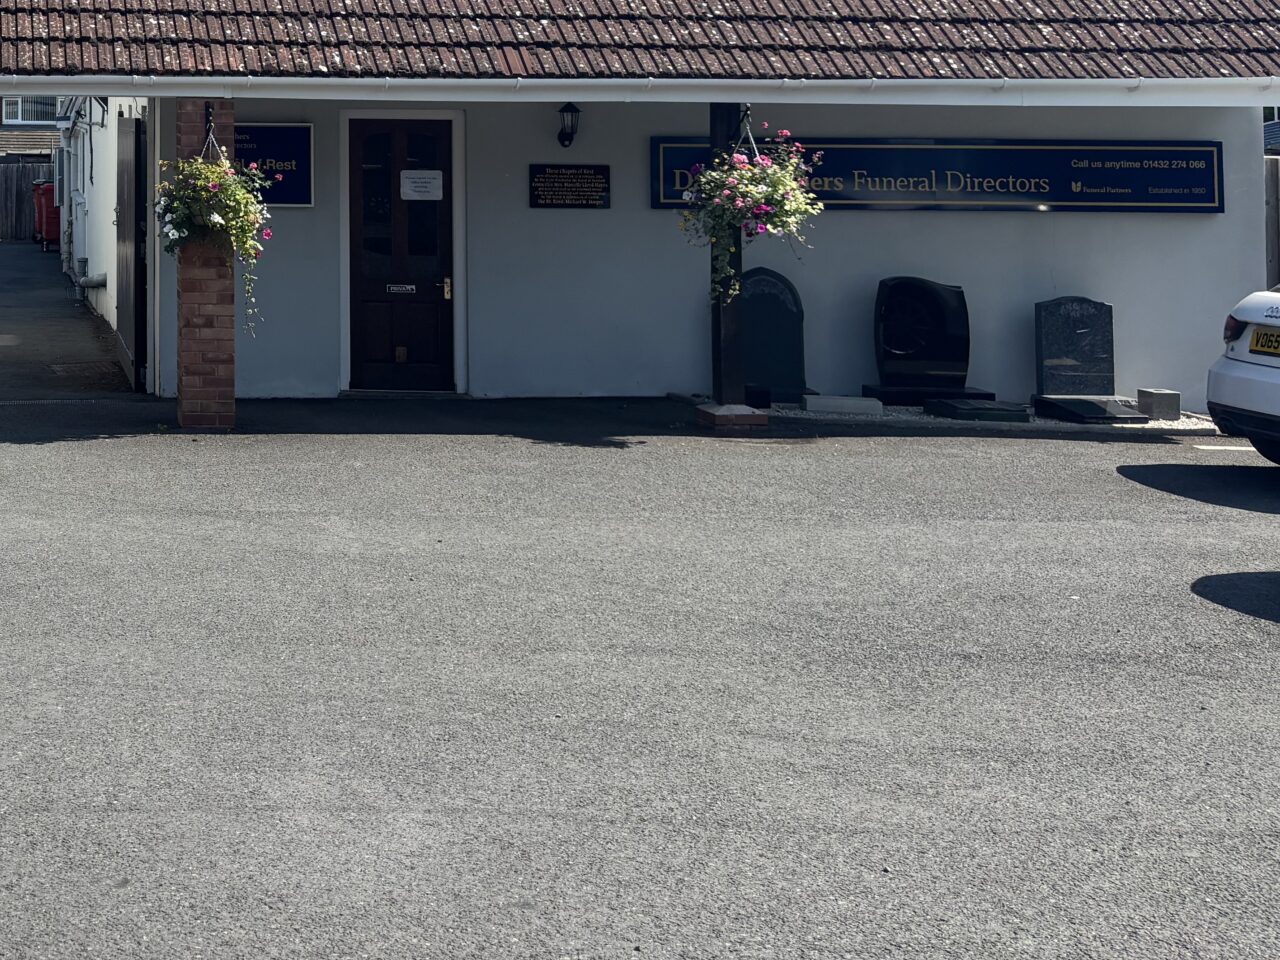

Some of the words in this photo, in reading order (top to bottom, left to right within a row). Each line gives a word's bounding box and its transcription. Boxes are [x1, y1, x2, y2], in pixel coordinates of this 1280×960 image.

[235, 132, 250, 140] hers
[267, 159, 297, 170] Rest
[1071, 159, 1089, 168] Call
[1104, 159, 1141, 170] anytime
[1143, 160, 1170, 169] 01432
[1171, 160, 1187, 169] 274
[1189, 160, 1206, 169] 066
[852, 170, 938, 192] Funeral
[945, 171, 1050, 193] Directors
